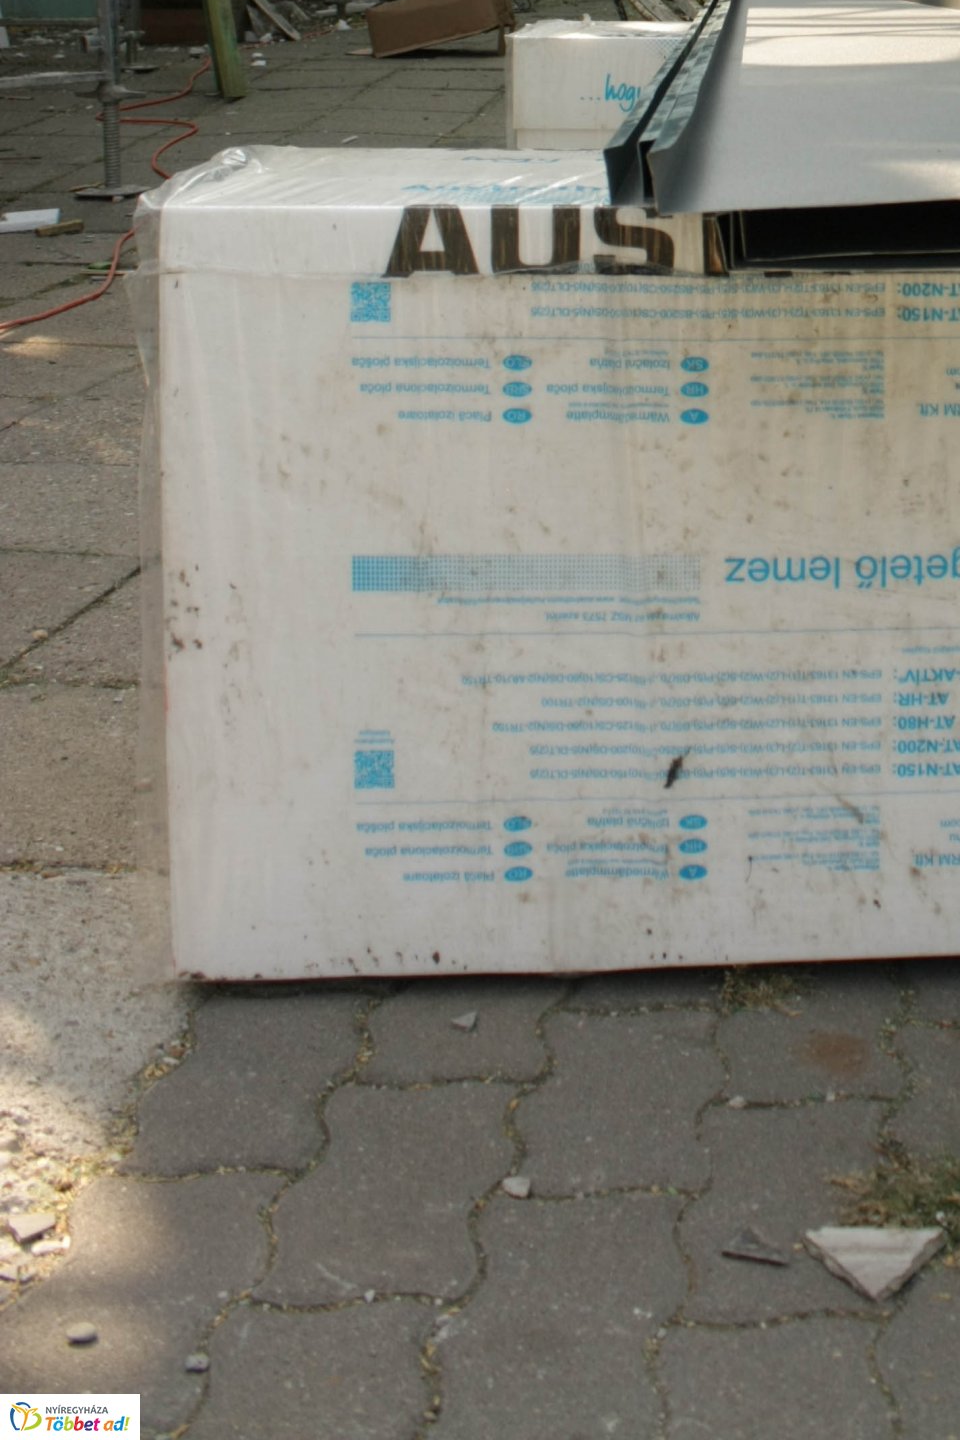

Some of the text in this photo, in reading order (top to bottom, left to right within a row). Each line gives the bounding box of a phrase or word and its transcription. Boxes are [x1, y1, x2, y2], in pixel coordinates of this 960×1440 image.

[359, 382, 392, 395] ploča
[724, 557, 840, 588] lemez
[892, 692, 949, 706] AT-HR:
[892, 714, 956, 730] AT-H80:
